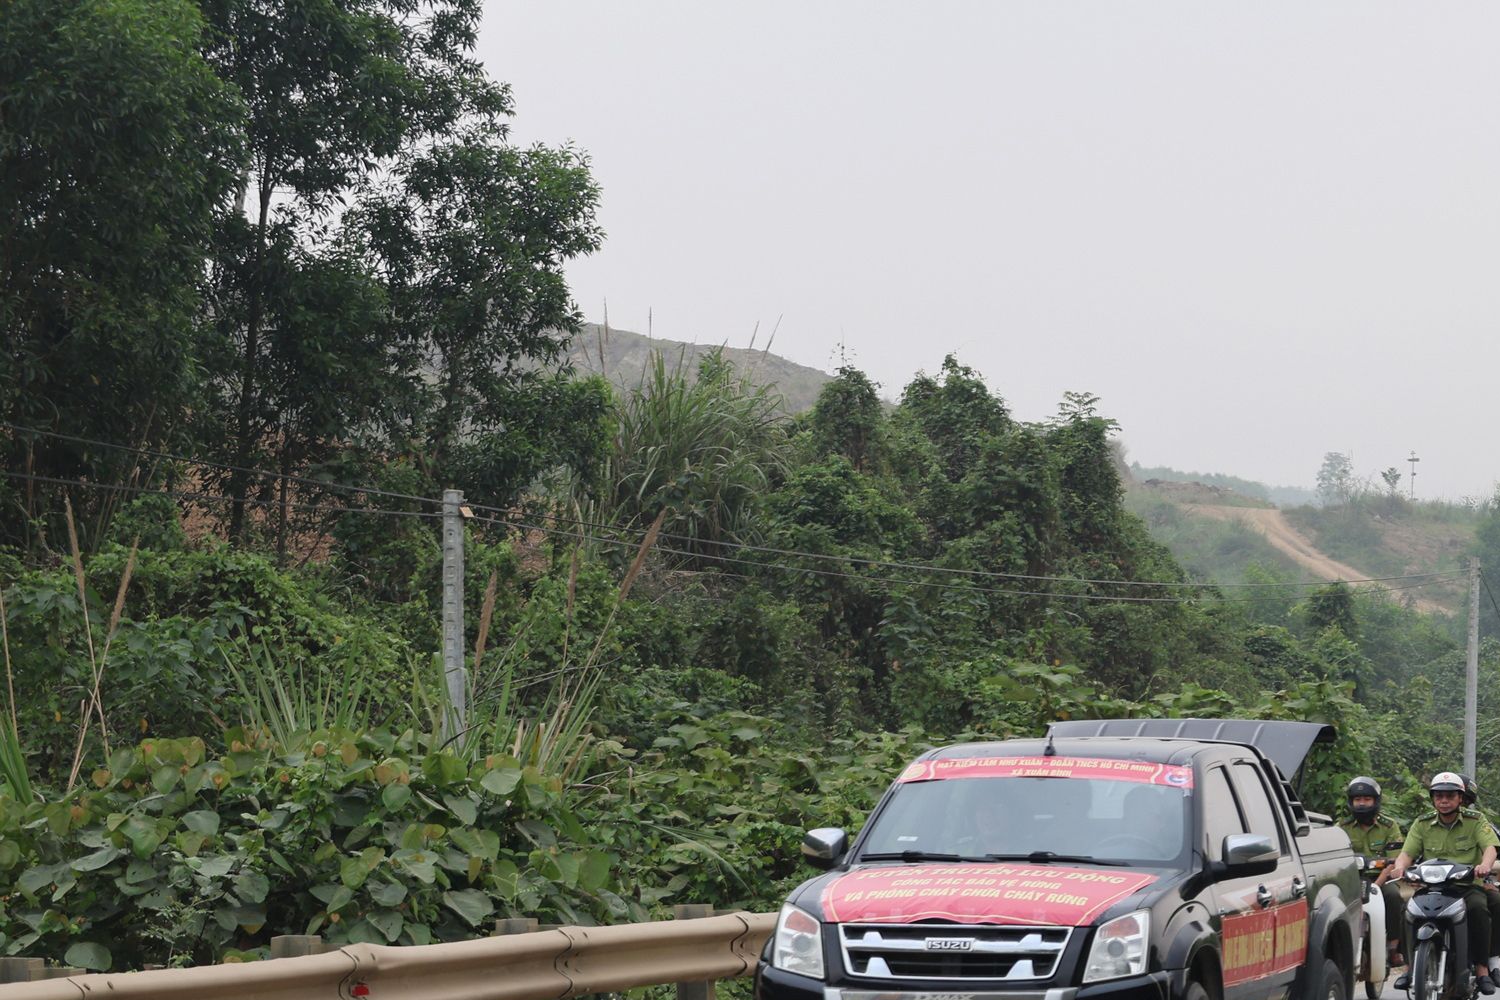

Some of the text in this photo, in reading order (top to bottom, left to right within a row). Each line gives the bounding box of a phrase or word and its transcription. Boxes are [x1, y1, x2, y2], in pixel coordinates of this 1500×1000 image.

[1018, 758, 1043, 767] XUÂN
[1075, 760, 1098, 768] TNCS
[1099, 760, 1113, 769] HỒ
[1113, 761, 1130, 770] CHÍ
[1130, 764, 1155, 773] MINH
[856, 866, 1127, 884] TUYÊN TRUYỀN LƯU ĐỘNG
[890, 876, 1062, 889] CÔNG TÁC BẢO VỆ RỪNG
[843, 887, 1089, 906] VÀ PHÒNG CHÁY CHỮA CHÁY RỪNG
[928, 940, 971, 950] ISUZU
